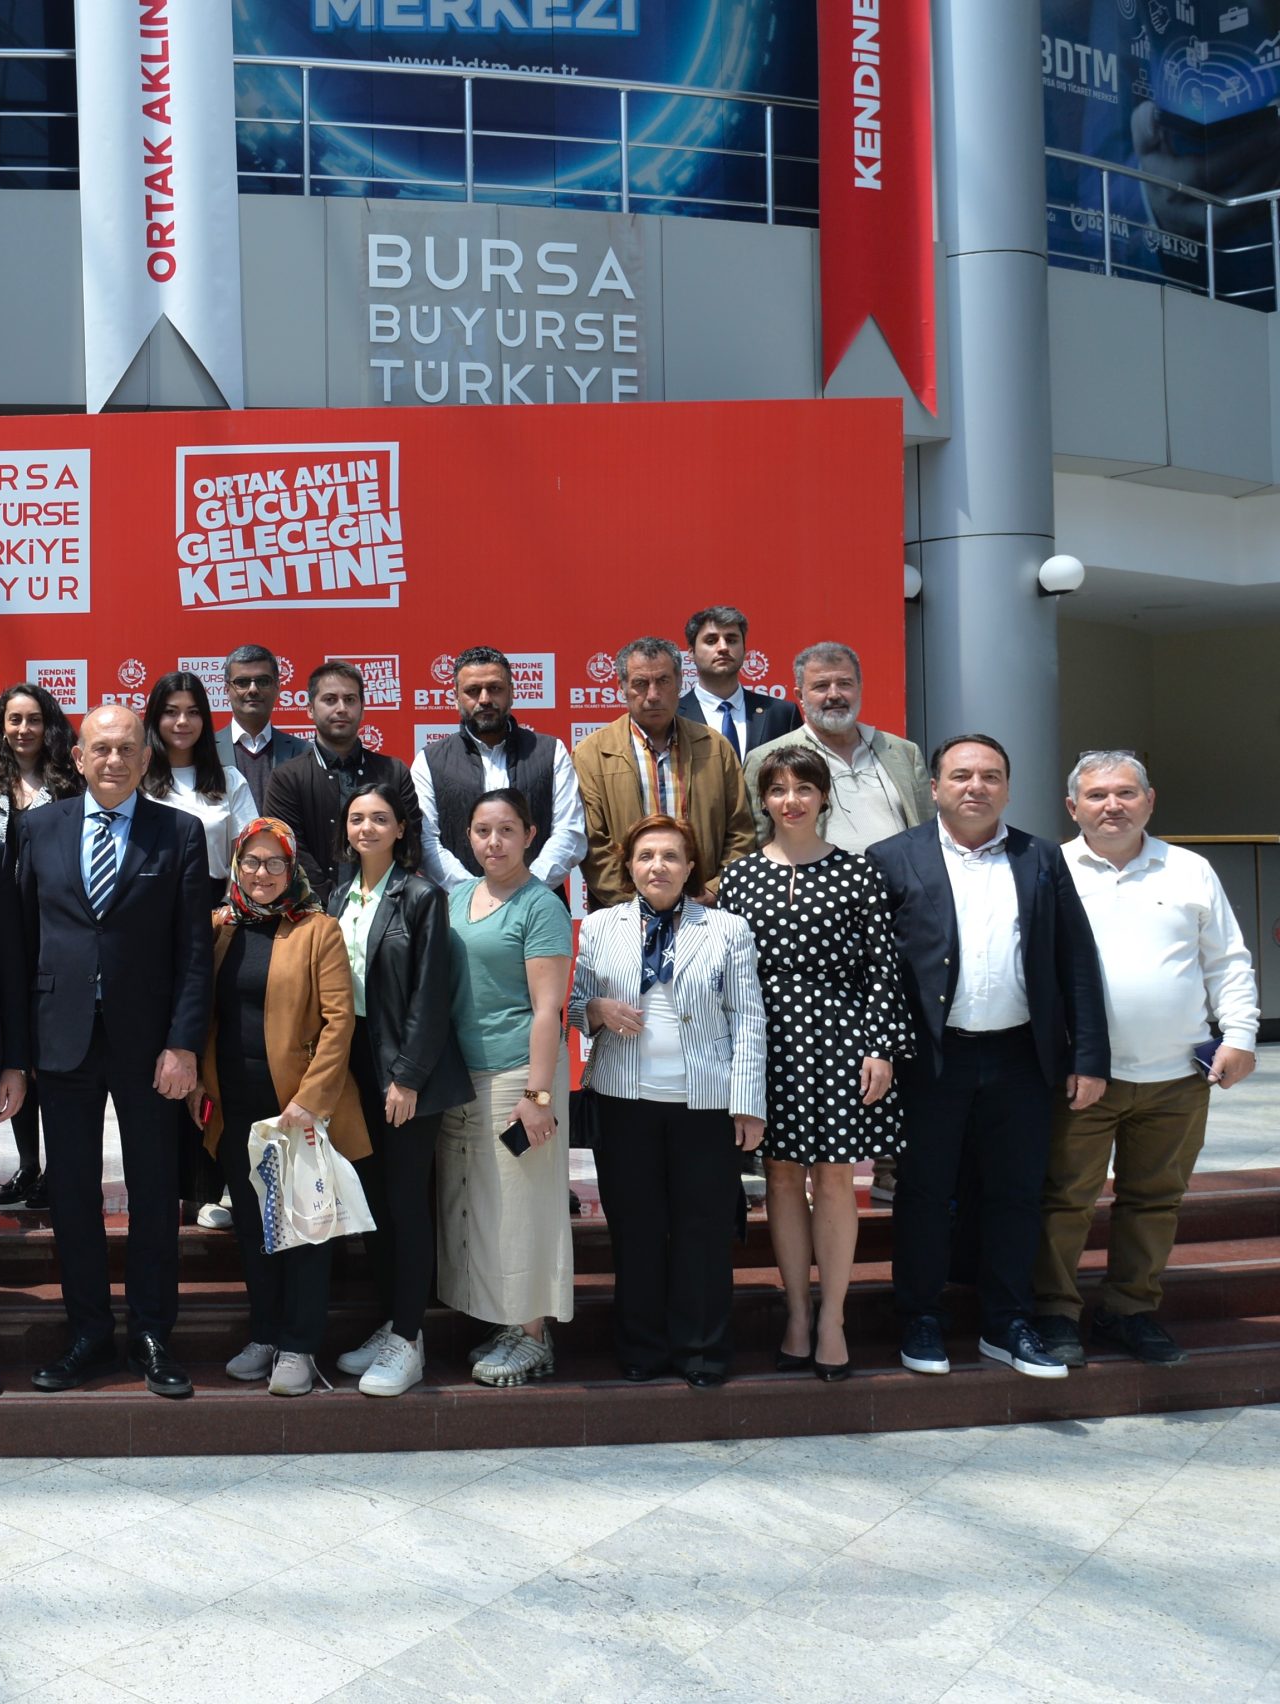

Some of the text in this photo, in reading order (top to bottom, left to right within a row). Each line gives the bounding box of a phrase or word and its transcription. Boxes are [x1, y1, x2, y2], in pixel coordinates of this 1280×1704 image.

[139, 0, 177, 283] ORTAK AKLIN
[368, 233, 636, 299] BURSA
[368, 304, 638, 354] BÜYÜRSE
[193, 459, 379, 500] ORTAK AKLIN
[364, 660, 392, 670] AKLIN
[512, 671, 543, 681] NAN
[102, 693, 151, 709] BTS
[279, 690, 310, 707] SO
[414, 689, 457, 705] BTS
